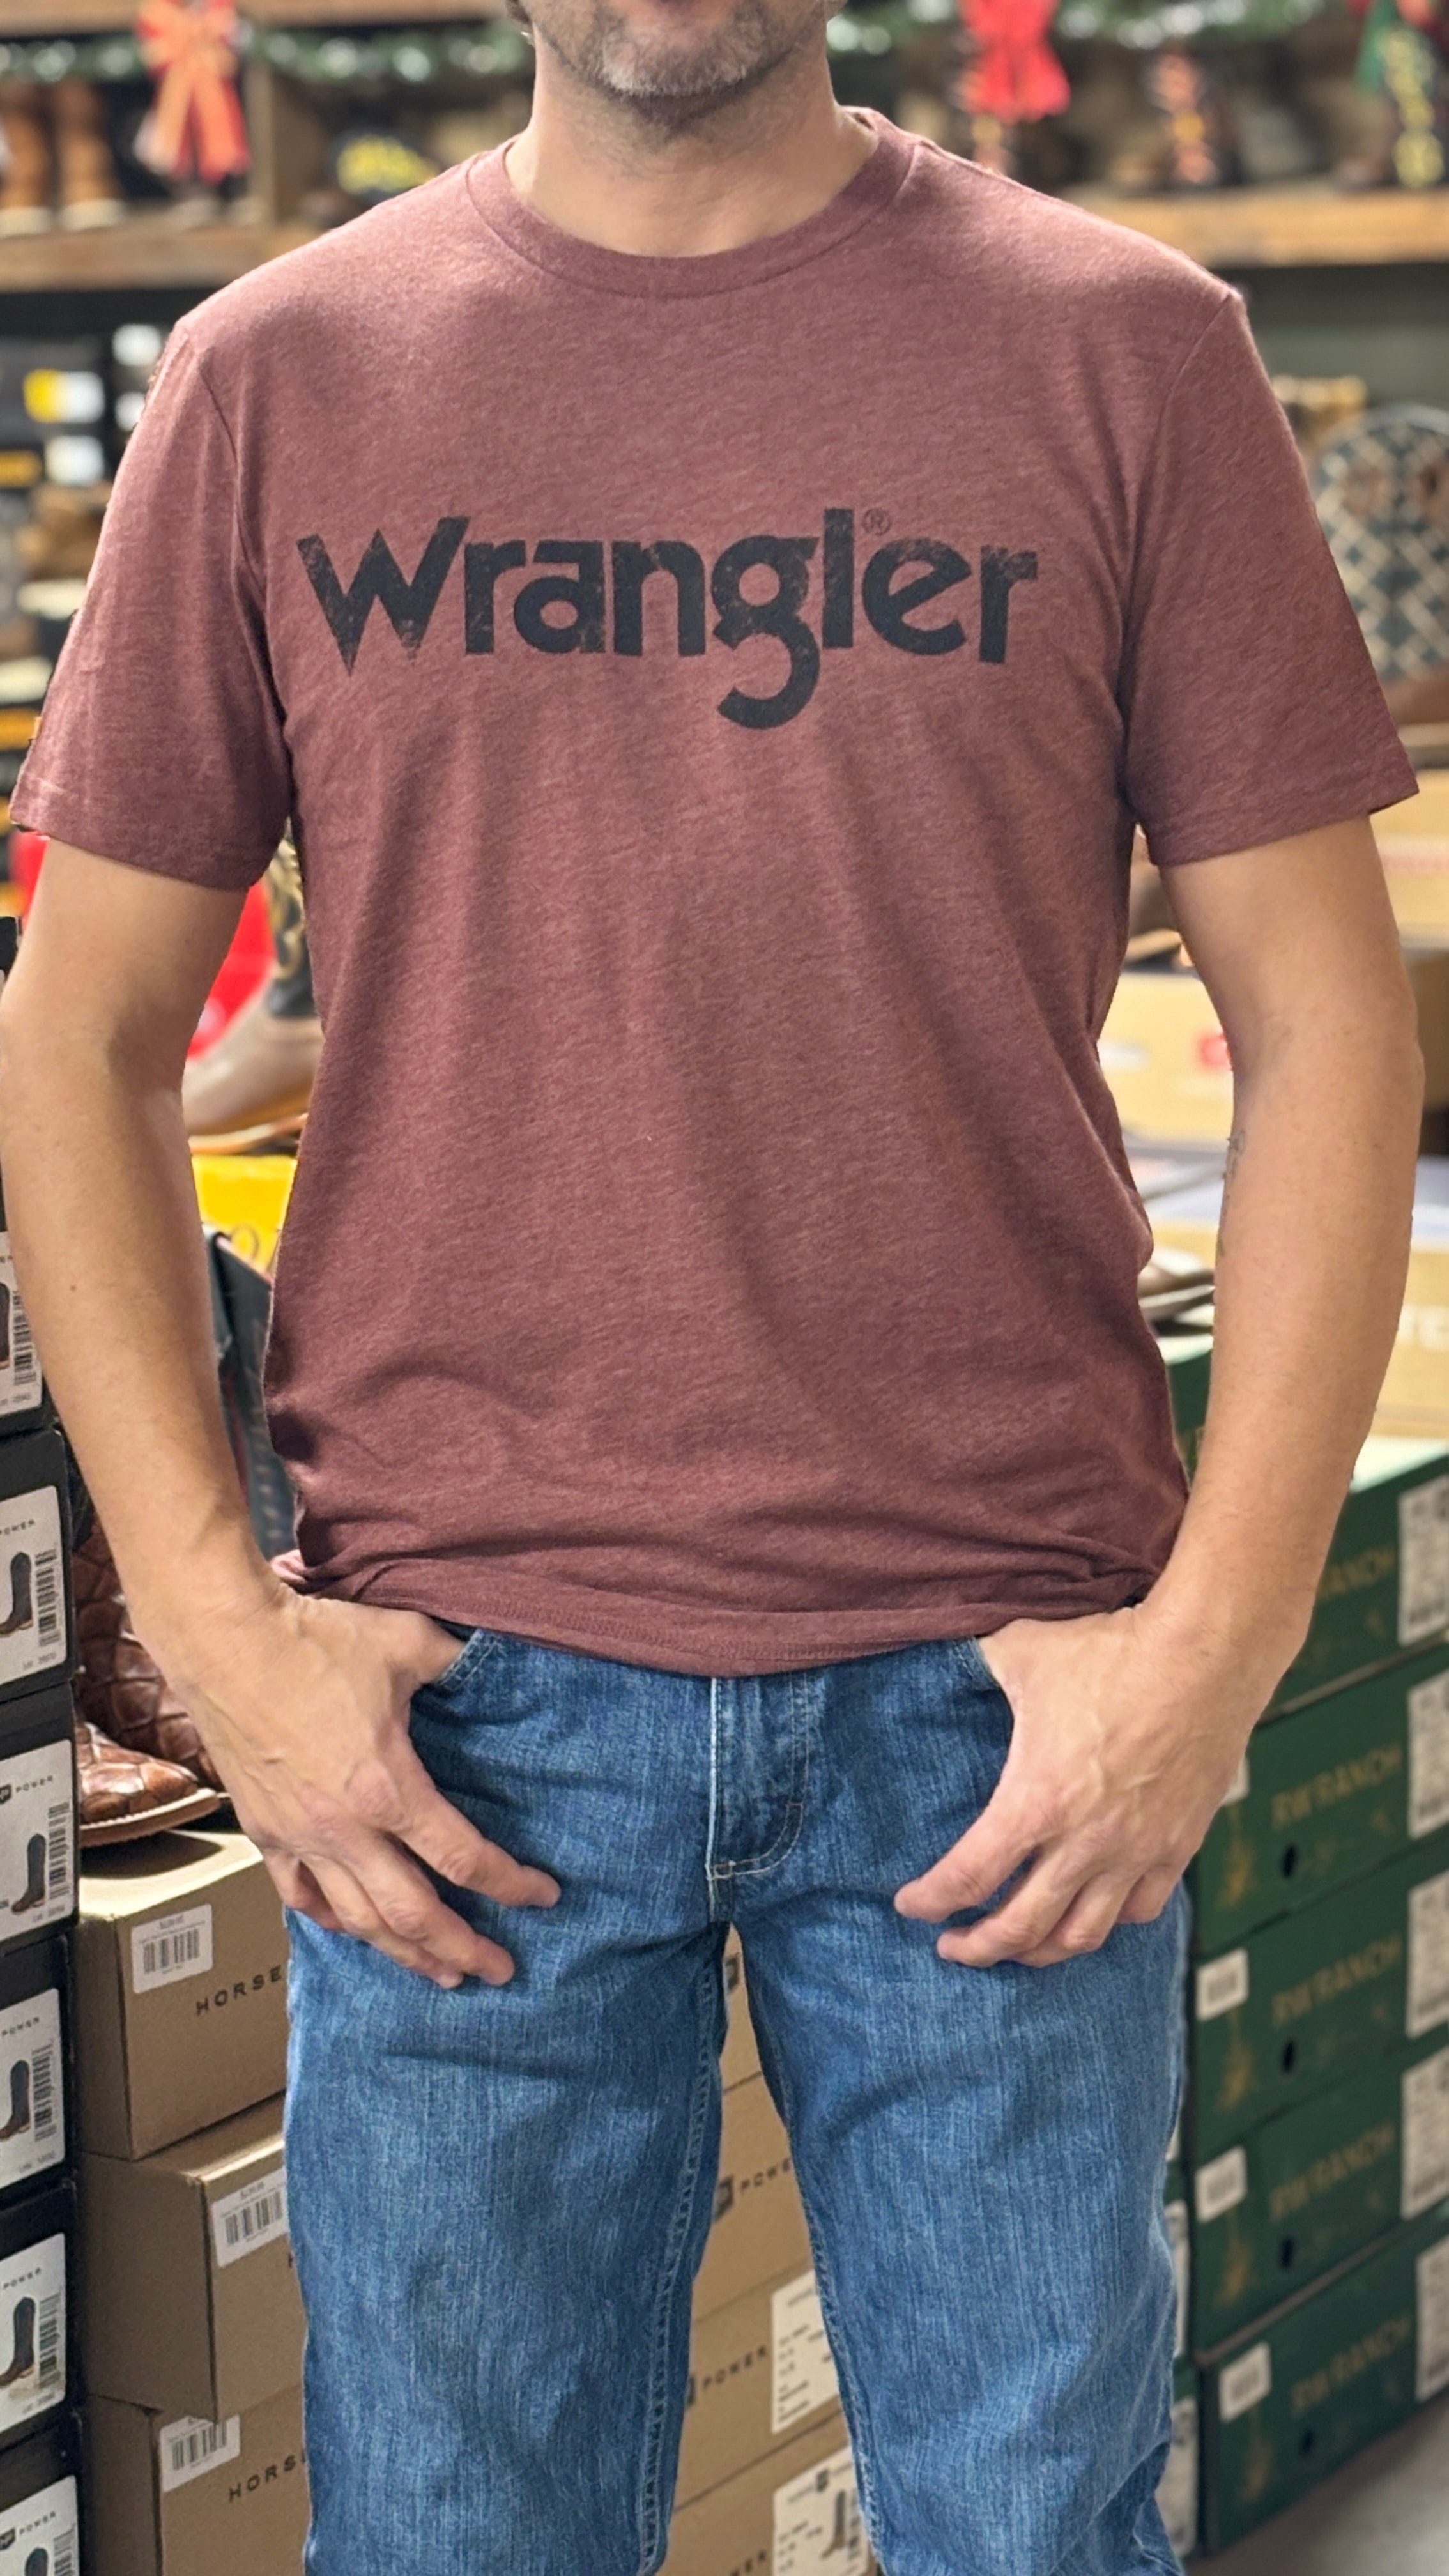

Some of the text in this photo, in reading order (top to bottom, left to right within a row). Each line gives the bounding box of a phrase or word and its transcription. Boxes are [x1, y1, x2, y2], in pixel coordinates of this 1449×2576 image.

[296, 507, 1039, 729] Wrangler
[0, 1519, 34, 1535] OWER
[1317, 1546, 1397, 1602] ANCH
[196, 1965, 282, 2016] HORSE
[1312, 1934, 1402, 2005] RANCH
[740, 2157, 792, 2194] POWE
